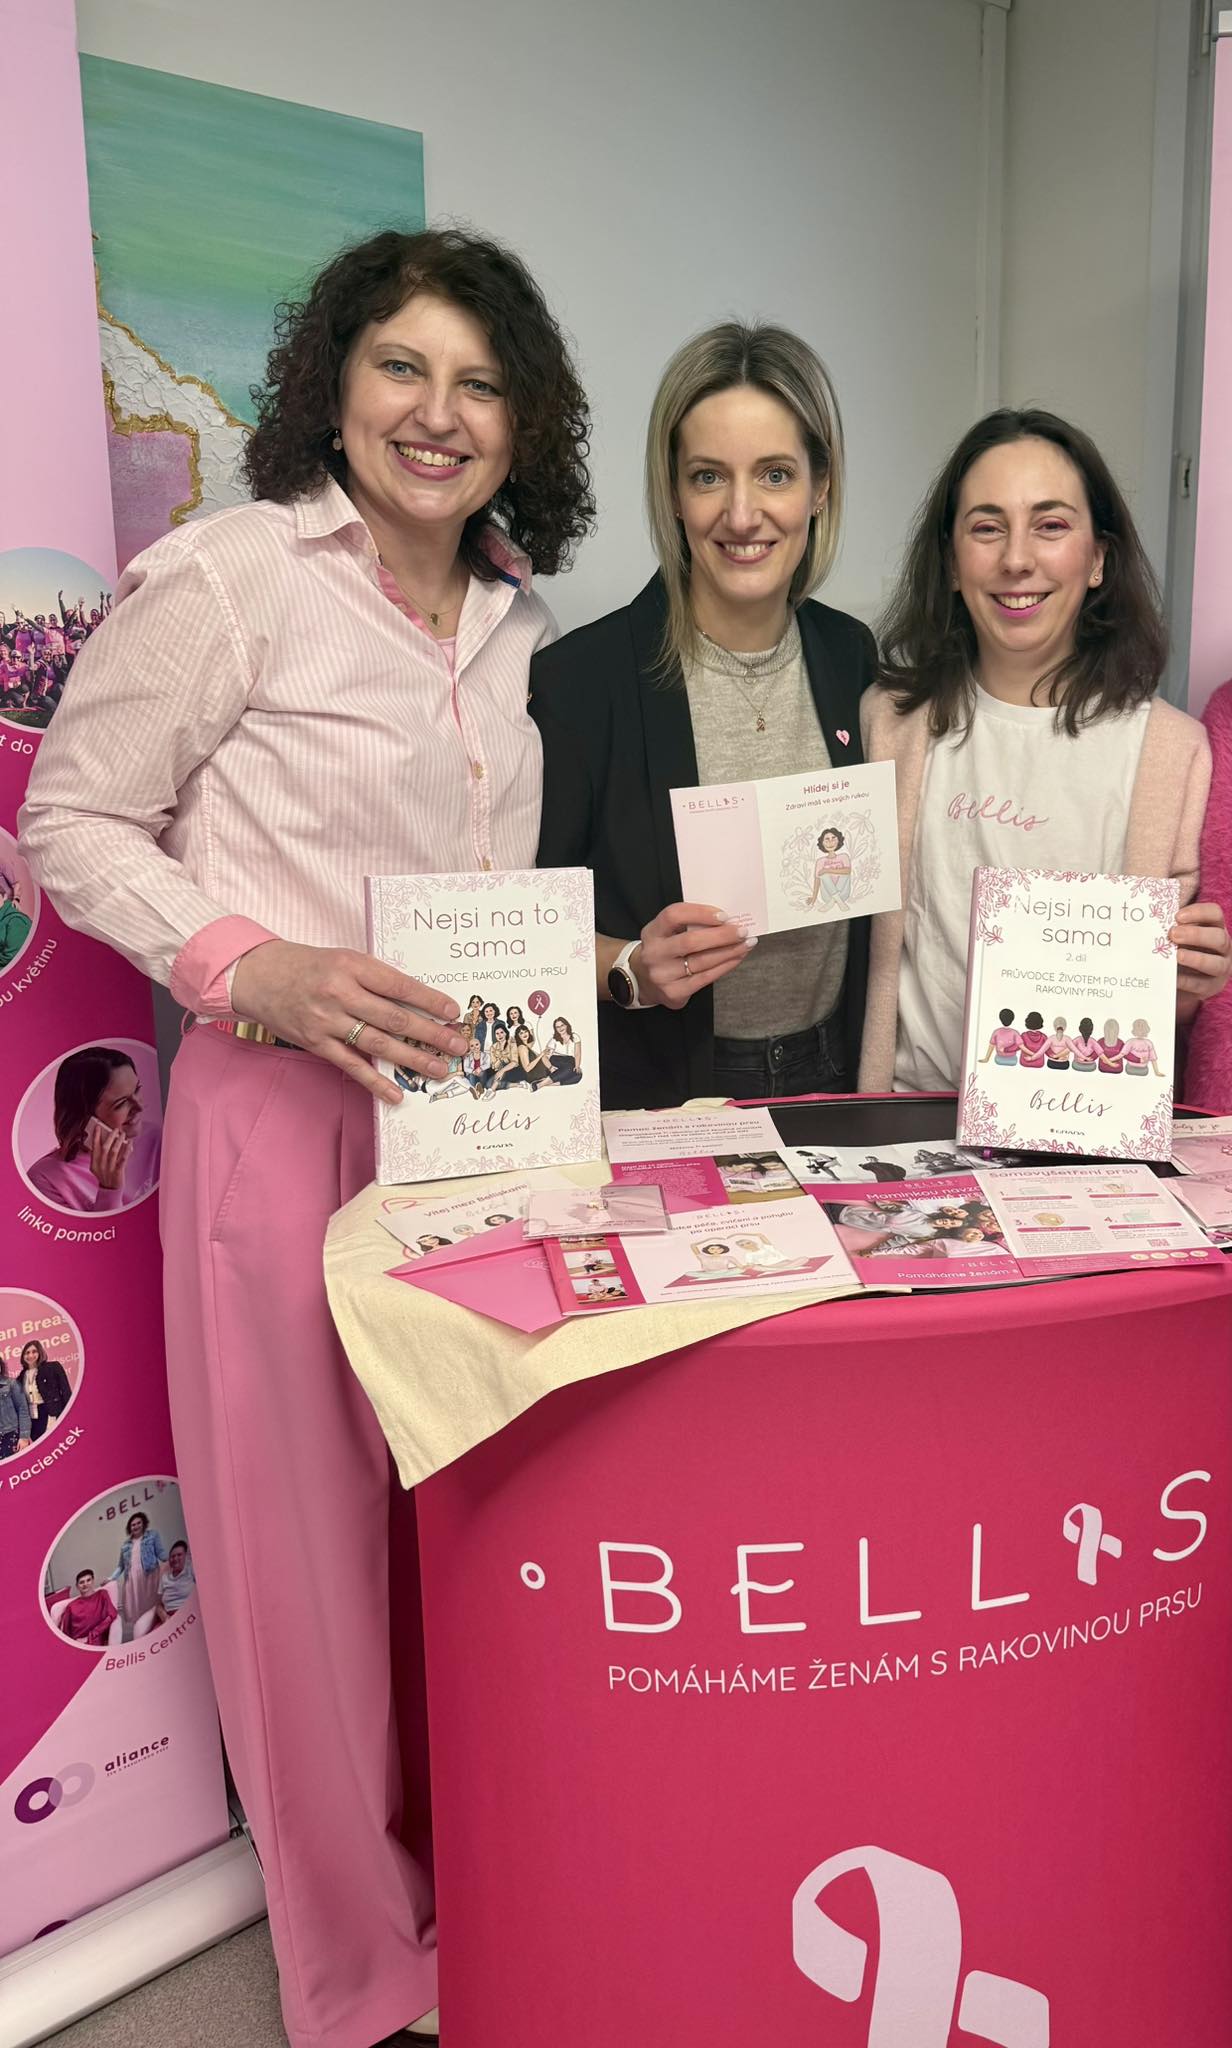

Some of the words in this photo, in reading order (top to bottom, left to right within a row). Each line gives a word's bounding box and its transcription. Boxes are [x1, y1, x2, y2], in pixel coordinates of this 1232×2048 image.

[11, 739, 33, 754] do
[803, 782, 829, 794] Hlídej
[832, 781, 839, 789] si
[841, 780, 850, 790] je
[786, 802, 806, 810] Zdraví
[948, 793, 1049, 831] Bellis
[1014, 895, 1071, 920] Nejsi
[1082, 903, 1112, 920] na
[1122, 902, 1144, 922] to
[414, 907, 479, 934] Nejsi
[491, 910, 524, 927] na
[534, 903, 558, 926] to
[1042, 928, 1112, 946] sama
[450, 938, 526, 958] sama
[1066, 952, 1074, 962] 2.
[1076, 953, 1087, 962] díl
[12, 938, 58, 993] květinu
[472, 968, 536, 981] RAKOVINOU
[540, 966, 568, 976] PRSU
[1001, 968, 1054, 982] PRŮVODCE
[1058, 970, 1101, 985] ŽIVOTEM
[1104, 977, 1118, 986] PO
[1036, 984, 1085, 996] RAKOVINY
[1087, 988, 1113, 998] PRSU
[1030, 1089, 1112, 1116] Bellis
[452, 1109, 540, 1136] Bellis
[988, 1168, 1102, 1178] Samovyšetření
[1106, 1168, 1138, 1176] prsu
[866, 1186, 940, 1200] Maminkou
[18, 1206, 54, 1234] linka
[54, 1226, 115, 1242] pomoci
[760, 1211, 794, 1222] pohybu
[740, 1222, 760, 1230] prsu
[897, 1271, 966, 1280] Pomáháme
[968, 1268, 1010, 1278] ženám
[9, 1426, 84, 1489] pacientek
[105, 1651, 146, 1670] Bellis
[150, 1613, 196, 1655] Centra
[608, 1663, 796, 1694] POMÁHÁME
[808, 1652, 920, 1691] ŽENÁM
[931, 1652, 948, 1677] S
[958, 1614, 1130, 1671] RAKOVINOU
[1139, 1582, 1202, 1629] PRSU
[104, 1736, 169, 1772] aliance
